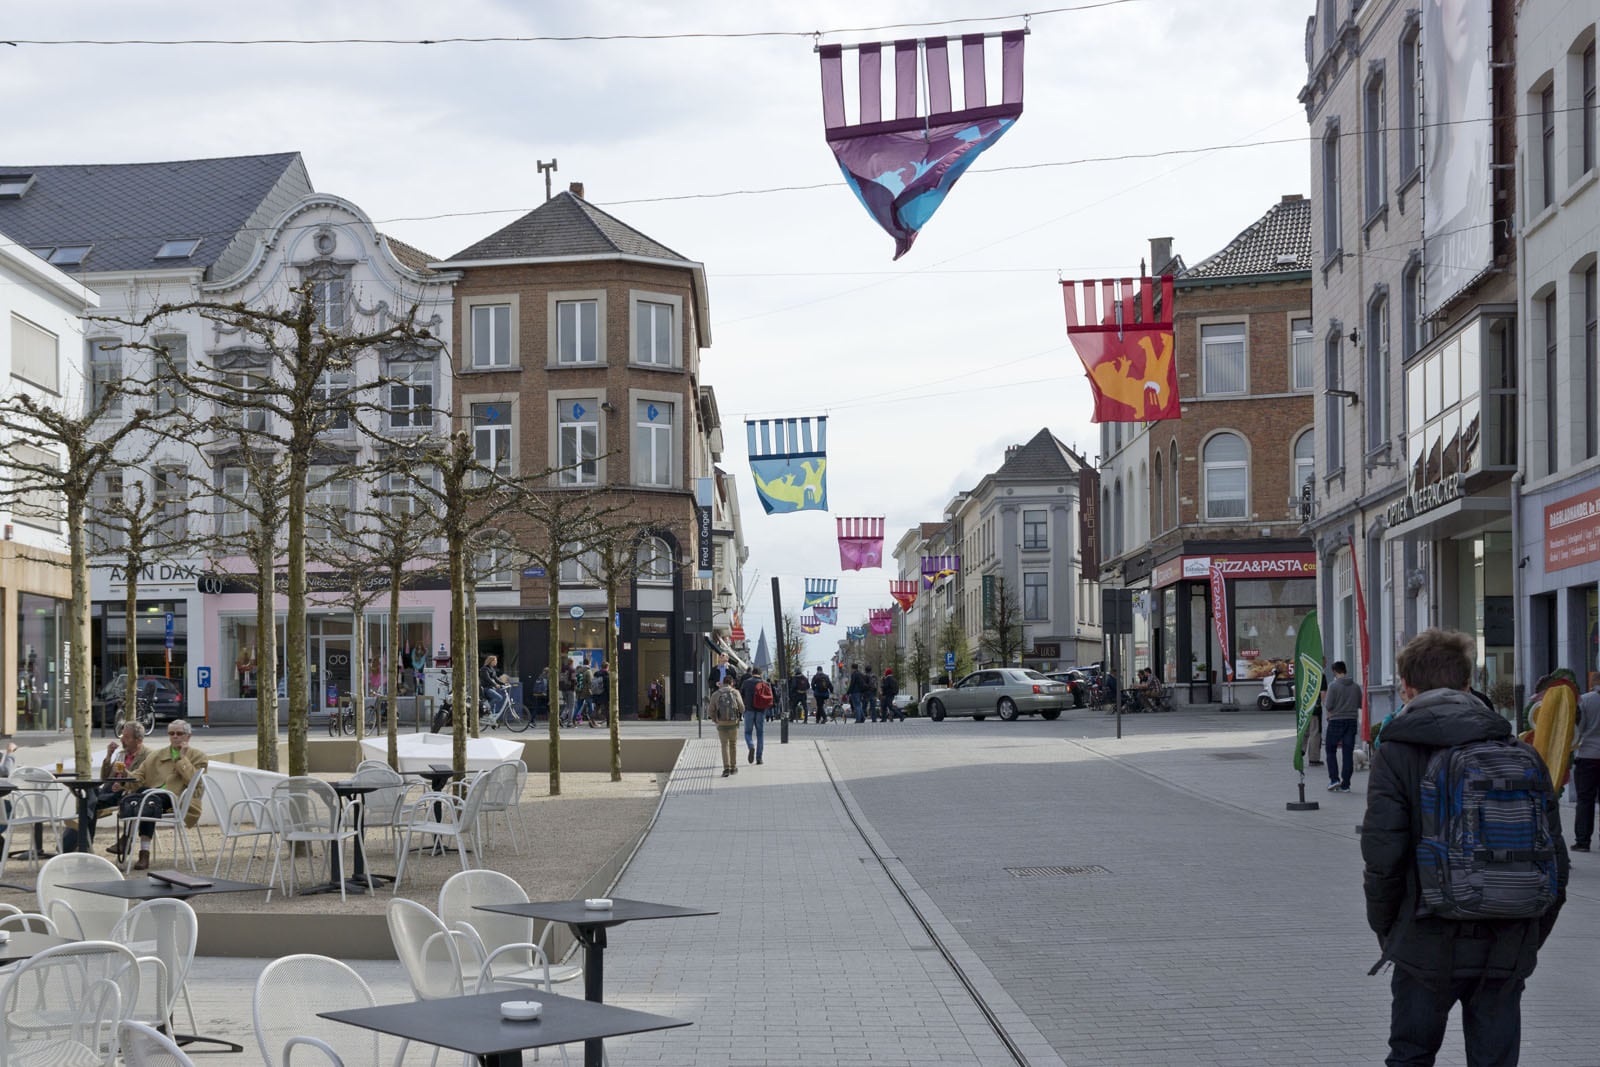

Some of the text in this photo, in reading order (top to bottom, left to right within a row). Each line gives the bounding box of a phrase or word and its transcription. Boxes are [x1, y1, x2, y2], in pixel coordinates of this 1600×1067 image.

[702, 510, 710, 537] Ginger
[160, 564, 196, 581] DAX
[1214, 559, 1302, 573] PIZZA&PASTA
